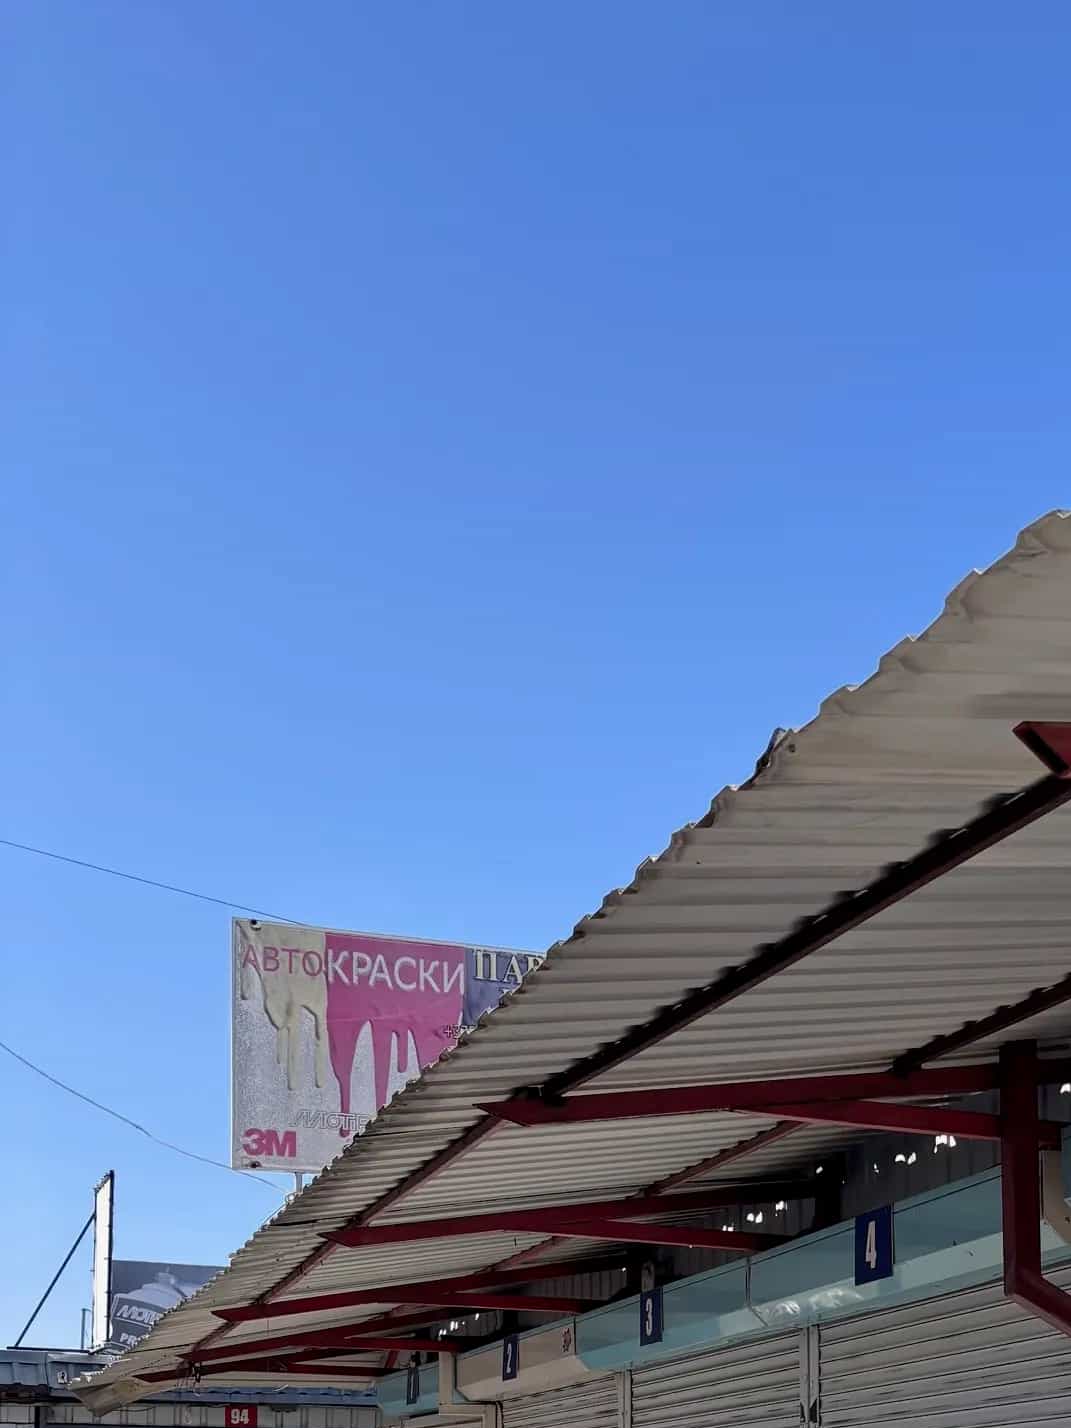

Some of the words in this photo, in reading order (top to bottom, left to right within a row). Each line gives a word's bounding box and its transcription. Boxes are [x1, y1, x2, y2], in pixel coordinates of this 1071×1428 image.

[242, 944, 465, 995] АВТОКРАСКИ
[242, 1128, 297, 1157] 3M
[865, 1220, 877, 1269] 4
[644, 1298, 654, 1336] 3
[506, 1343, 513, 1374] 2
[231, 1408, 249, 1425] 94
